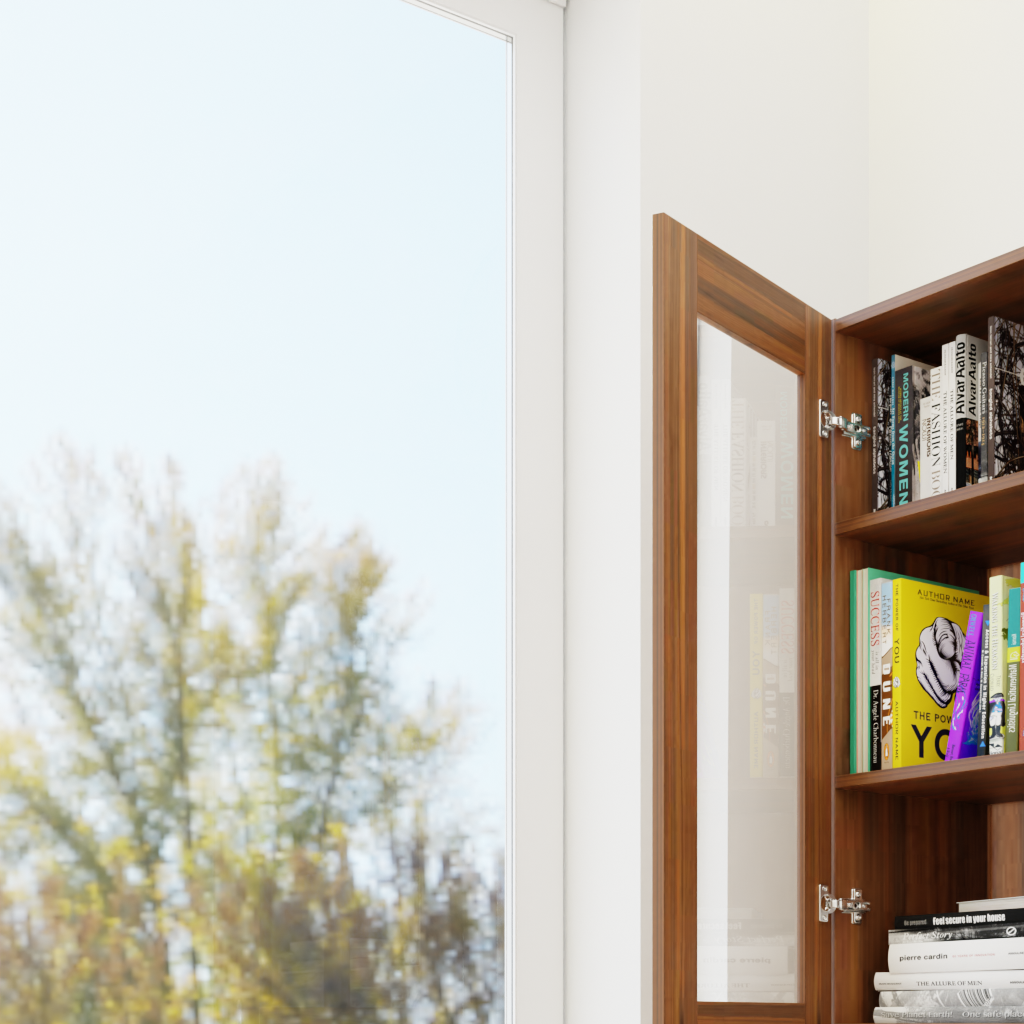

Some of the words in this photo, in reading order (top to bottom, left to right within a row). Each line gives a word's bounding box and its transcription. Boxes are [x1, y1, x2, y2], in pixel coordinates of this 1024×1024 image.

[956, 342, 965, 378] Aalto
[932, 368, 940, 402] THE
[956, 380, 964, 414] Alvar
[932, 403, 940, 466] FASHION
[943, 435, 947, 444] OF
[898, 424, 908, 505] WOMEN
[918, 589, 950, 601] AUTHOR
[953, 596, 975, 606] NAME
[871, 591, 879, 647] SUCCESS
[967, 613, 978, 636] ORWELL
[961, 639, 976, 670] ANIMAL
[882, 663, 890, 726] DUNE
[956, 673, 970, 694] FARM
[914, 711, 931, 721] THE
[933, 917, 945, 925] Feel
[946, 915, 965, 924] secure
[966, 915, 972, 923] in
[973, 914, 986, 924] your
[987, 913, 1006, 922] house
[903, 932, 930, 940] Perfect
[932, 930, 953, 939] Story
